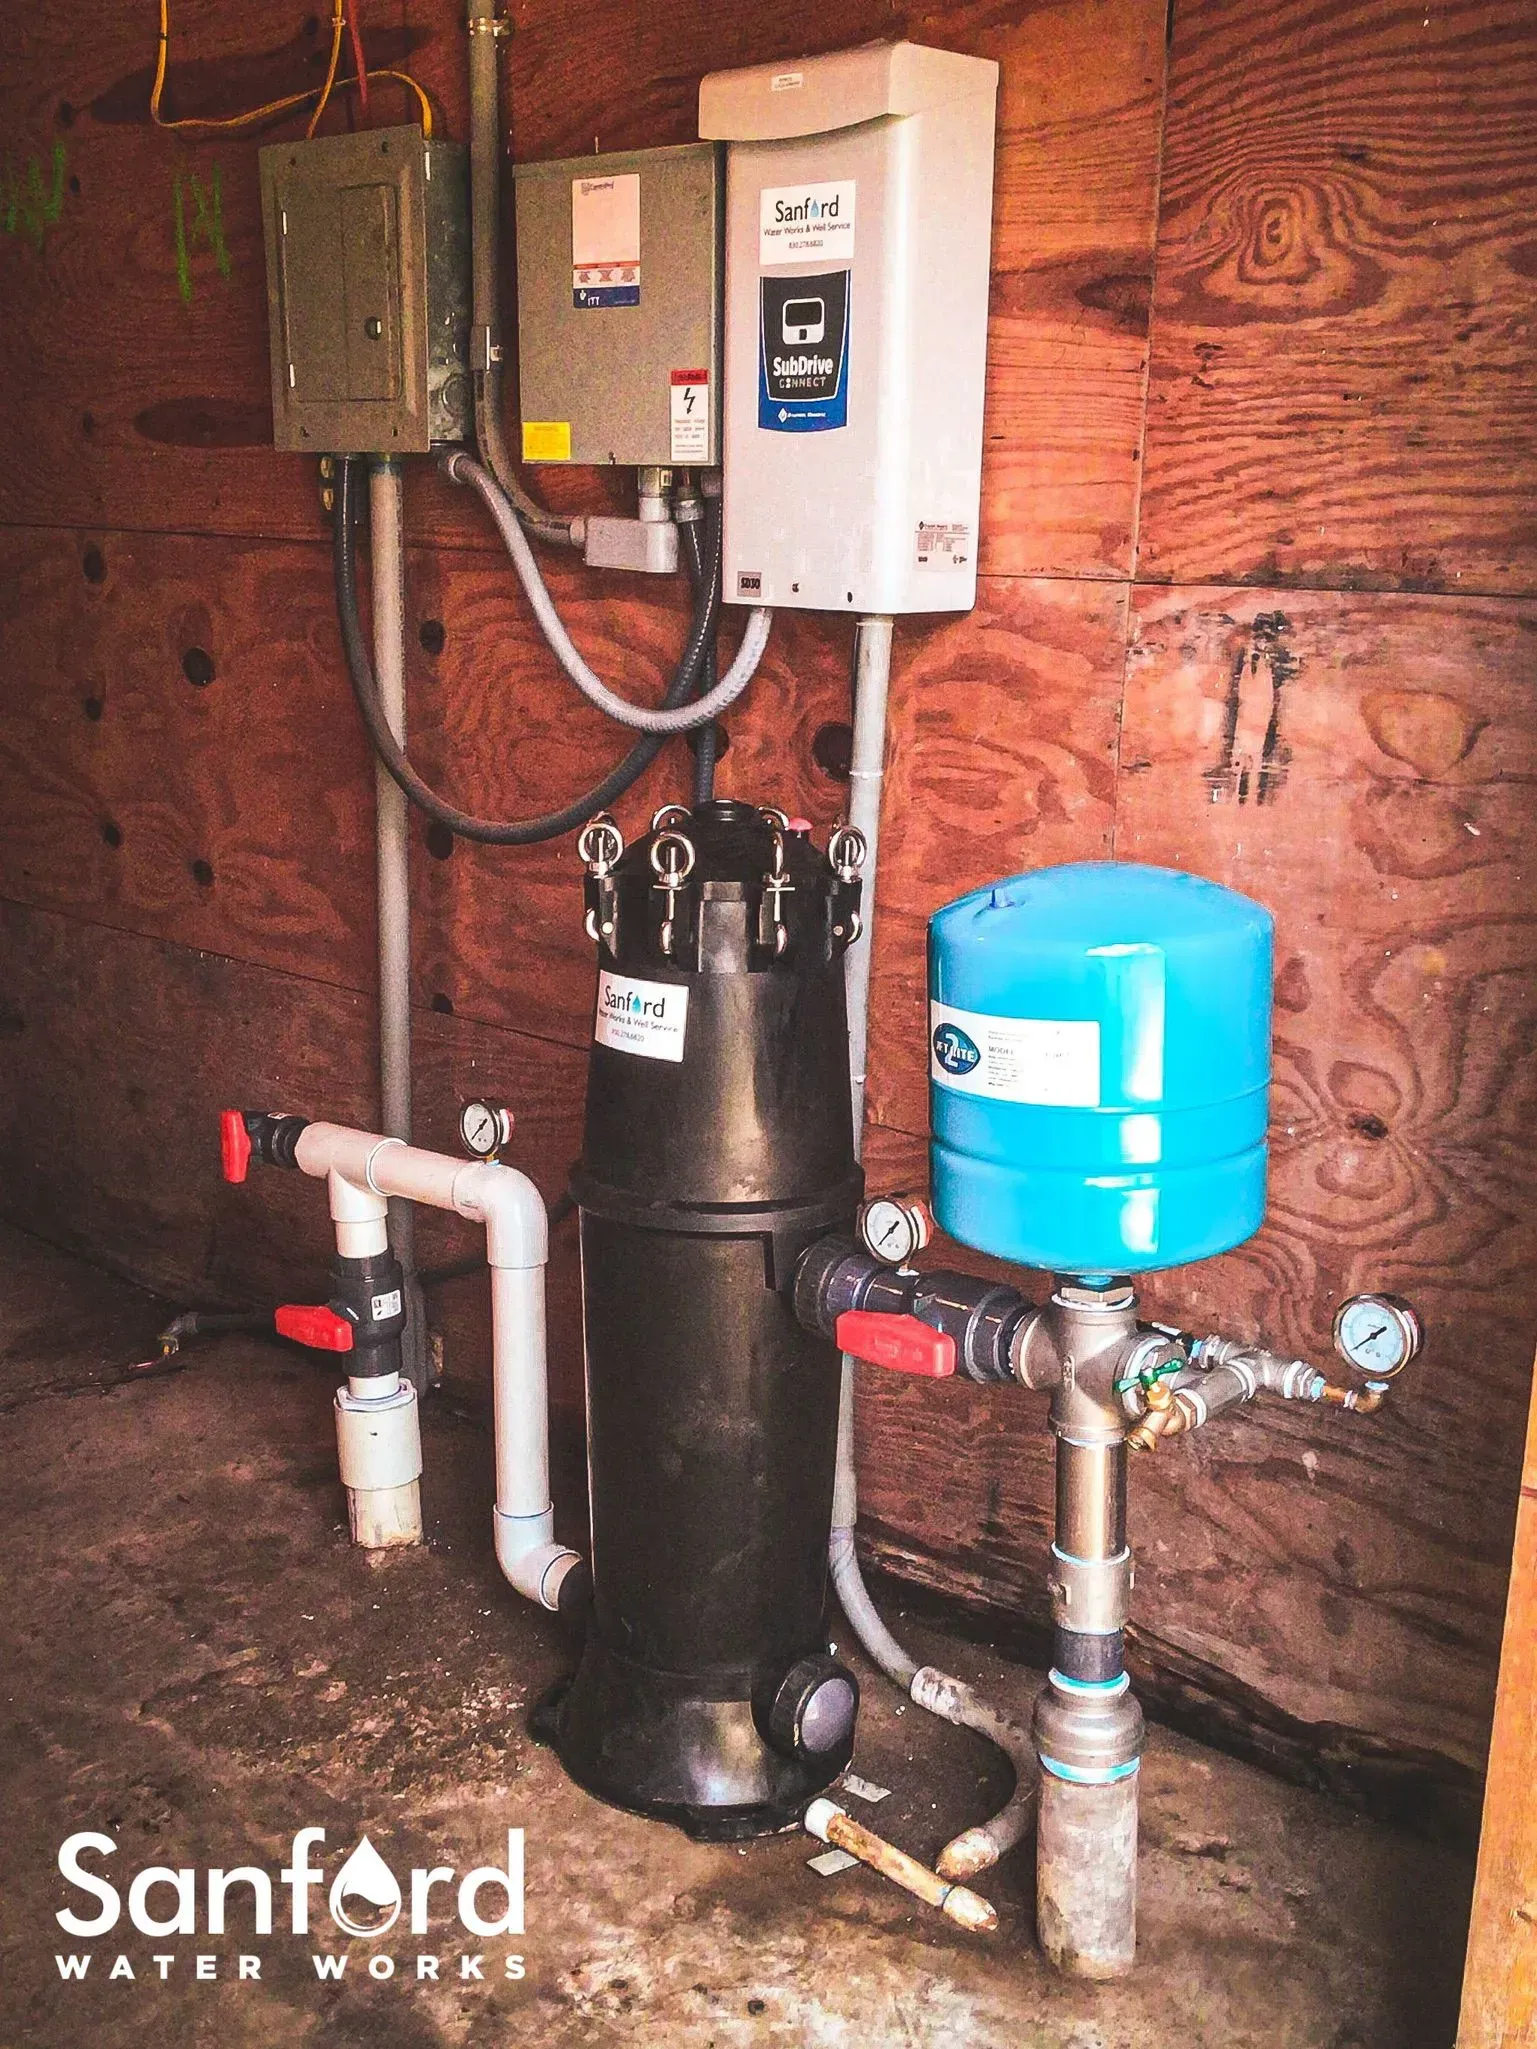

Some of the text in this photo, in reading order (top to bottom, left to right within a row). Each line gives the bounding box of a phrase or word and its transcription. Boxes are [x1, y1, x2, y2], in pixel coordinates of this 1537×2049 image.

[775, 194, 840, 223] Sanford
[772, 354, 834, 377] SubDrive
[779, 377, 827, 389] CONNECT
[604, 985, 666, 1018] Sanford
